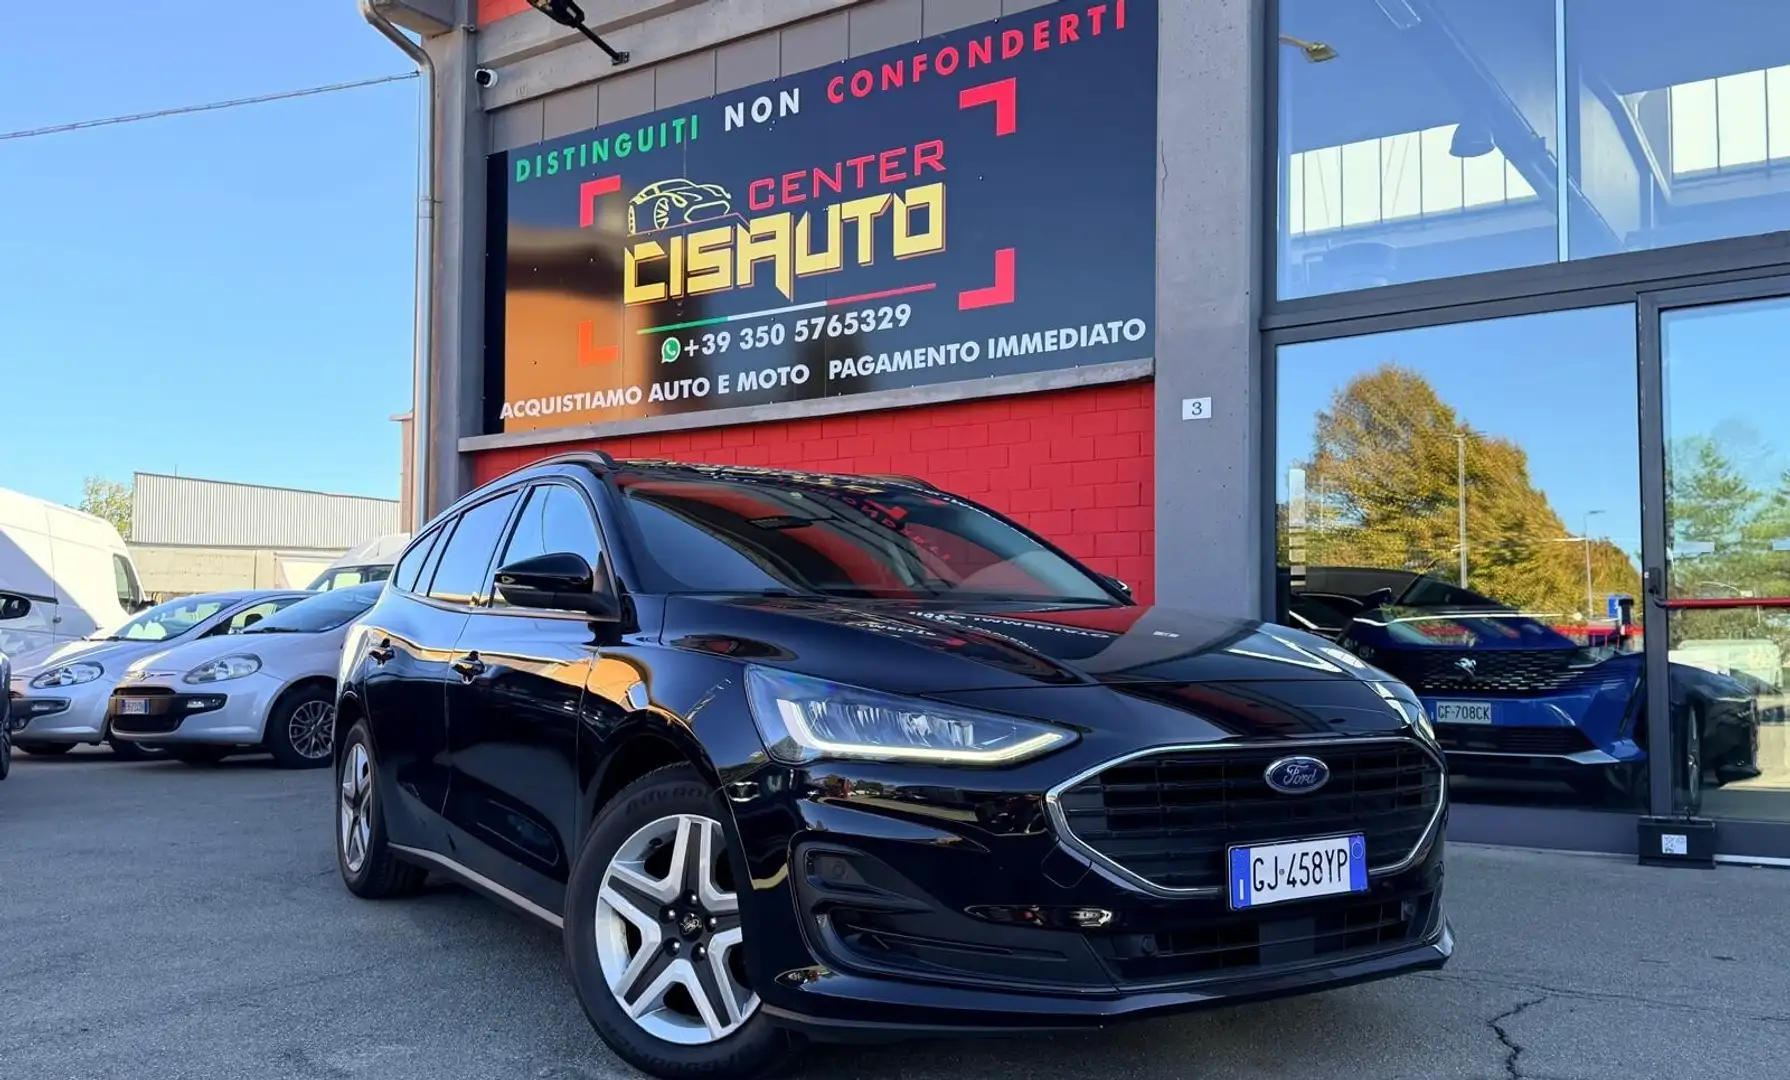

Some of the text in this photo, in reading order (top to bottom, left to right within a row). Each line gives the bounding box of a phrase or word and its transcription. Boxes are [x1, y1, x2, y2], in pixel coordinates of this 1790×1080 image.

[515, 0, 1126, 183] DISTINGUITI NON CONFONDERTI
[748, 138, 947, 211] CENTER
[623, 181, 947, 306] CISAUTO
[683, 302, 912, 358] +39 350 5765329
[500, 317, 1146, 420] ACQUISTIAMO AUTO E MOTO PAGAMENTO IMMEDIATO
[1191, 401, 1203, 416] 3
[1282, 763, 1318, 786] Ford
